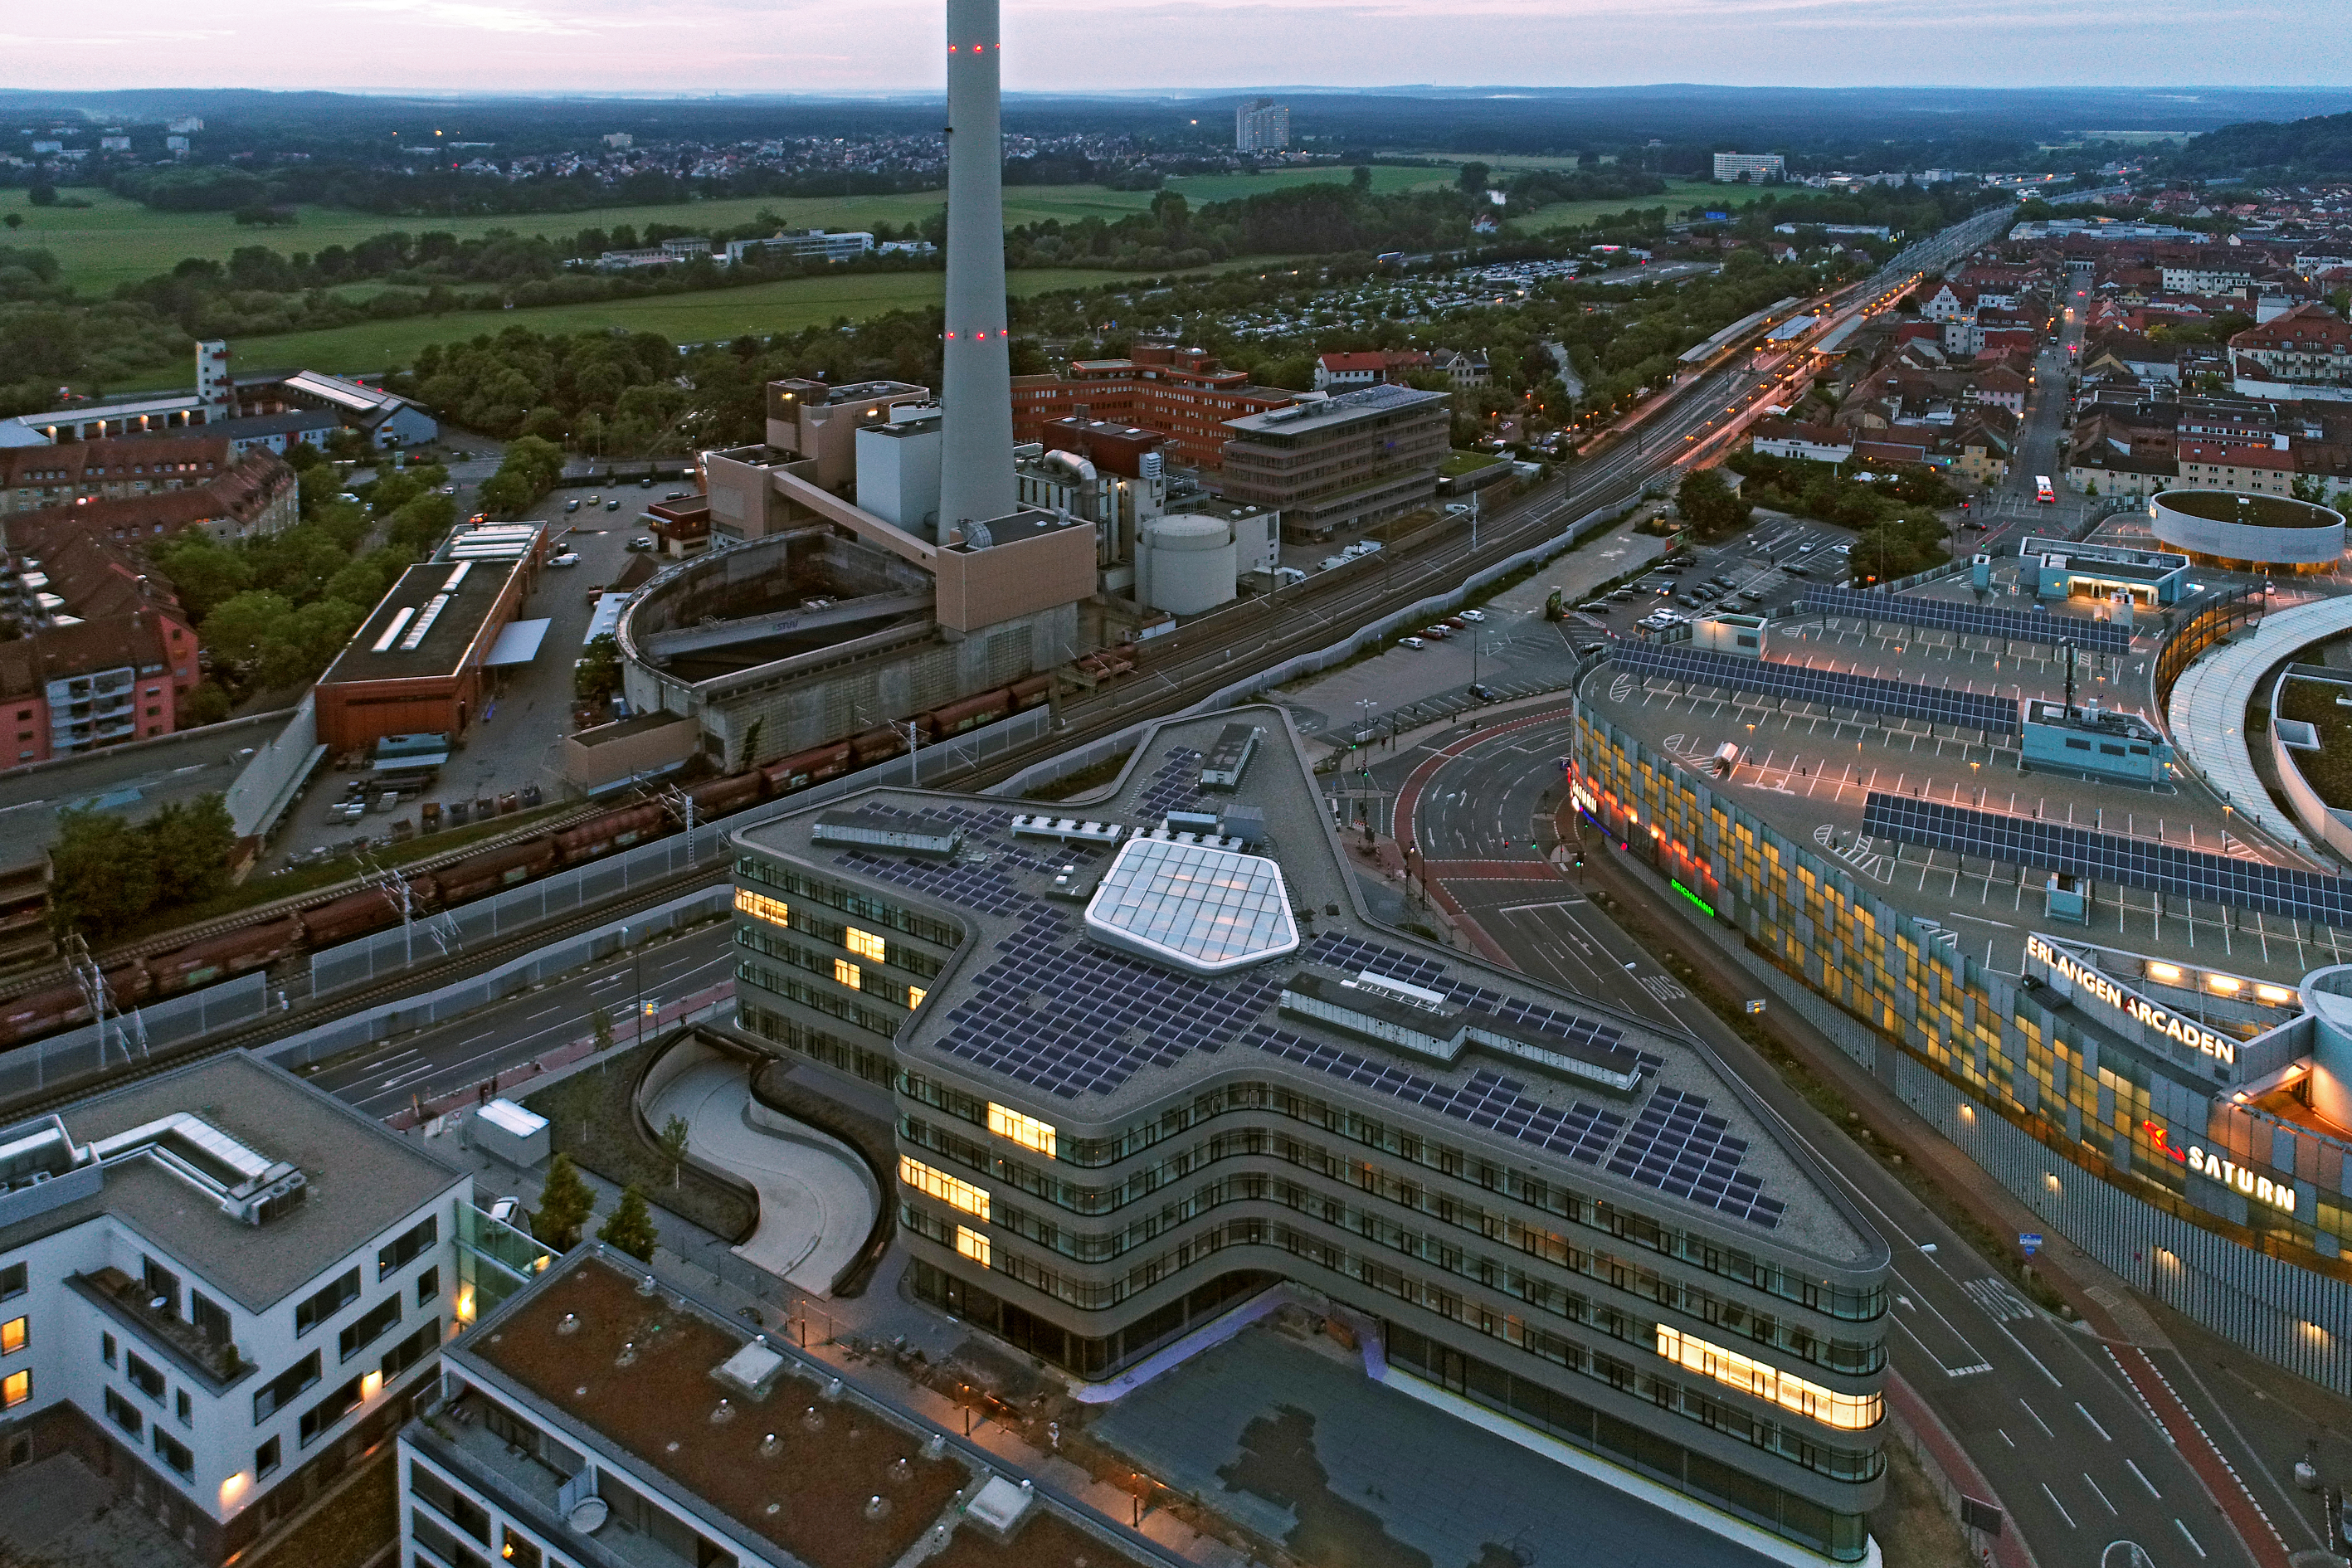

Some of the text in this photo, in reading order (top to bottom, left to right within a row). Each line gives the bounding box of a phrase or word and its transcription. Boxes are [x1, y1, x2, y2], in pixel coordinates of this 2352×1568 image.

[1671, 878, 1714, 917] DEICHMANN
[1640, 974, 1687, 1001] BUS
[2027, 935, 2235, 1065] ERLANGEN ARCADEN
[2189, 1145, 2296, 1212] SATURN
[1963, 1277, 2034, 1322] BUS
